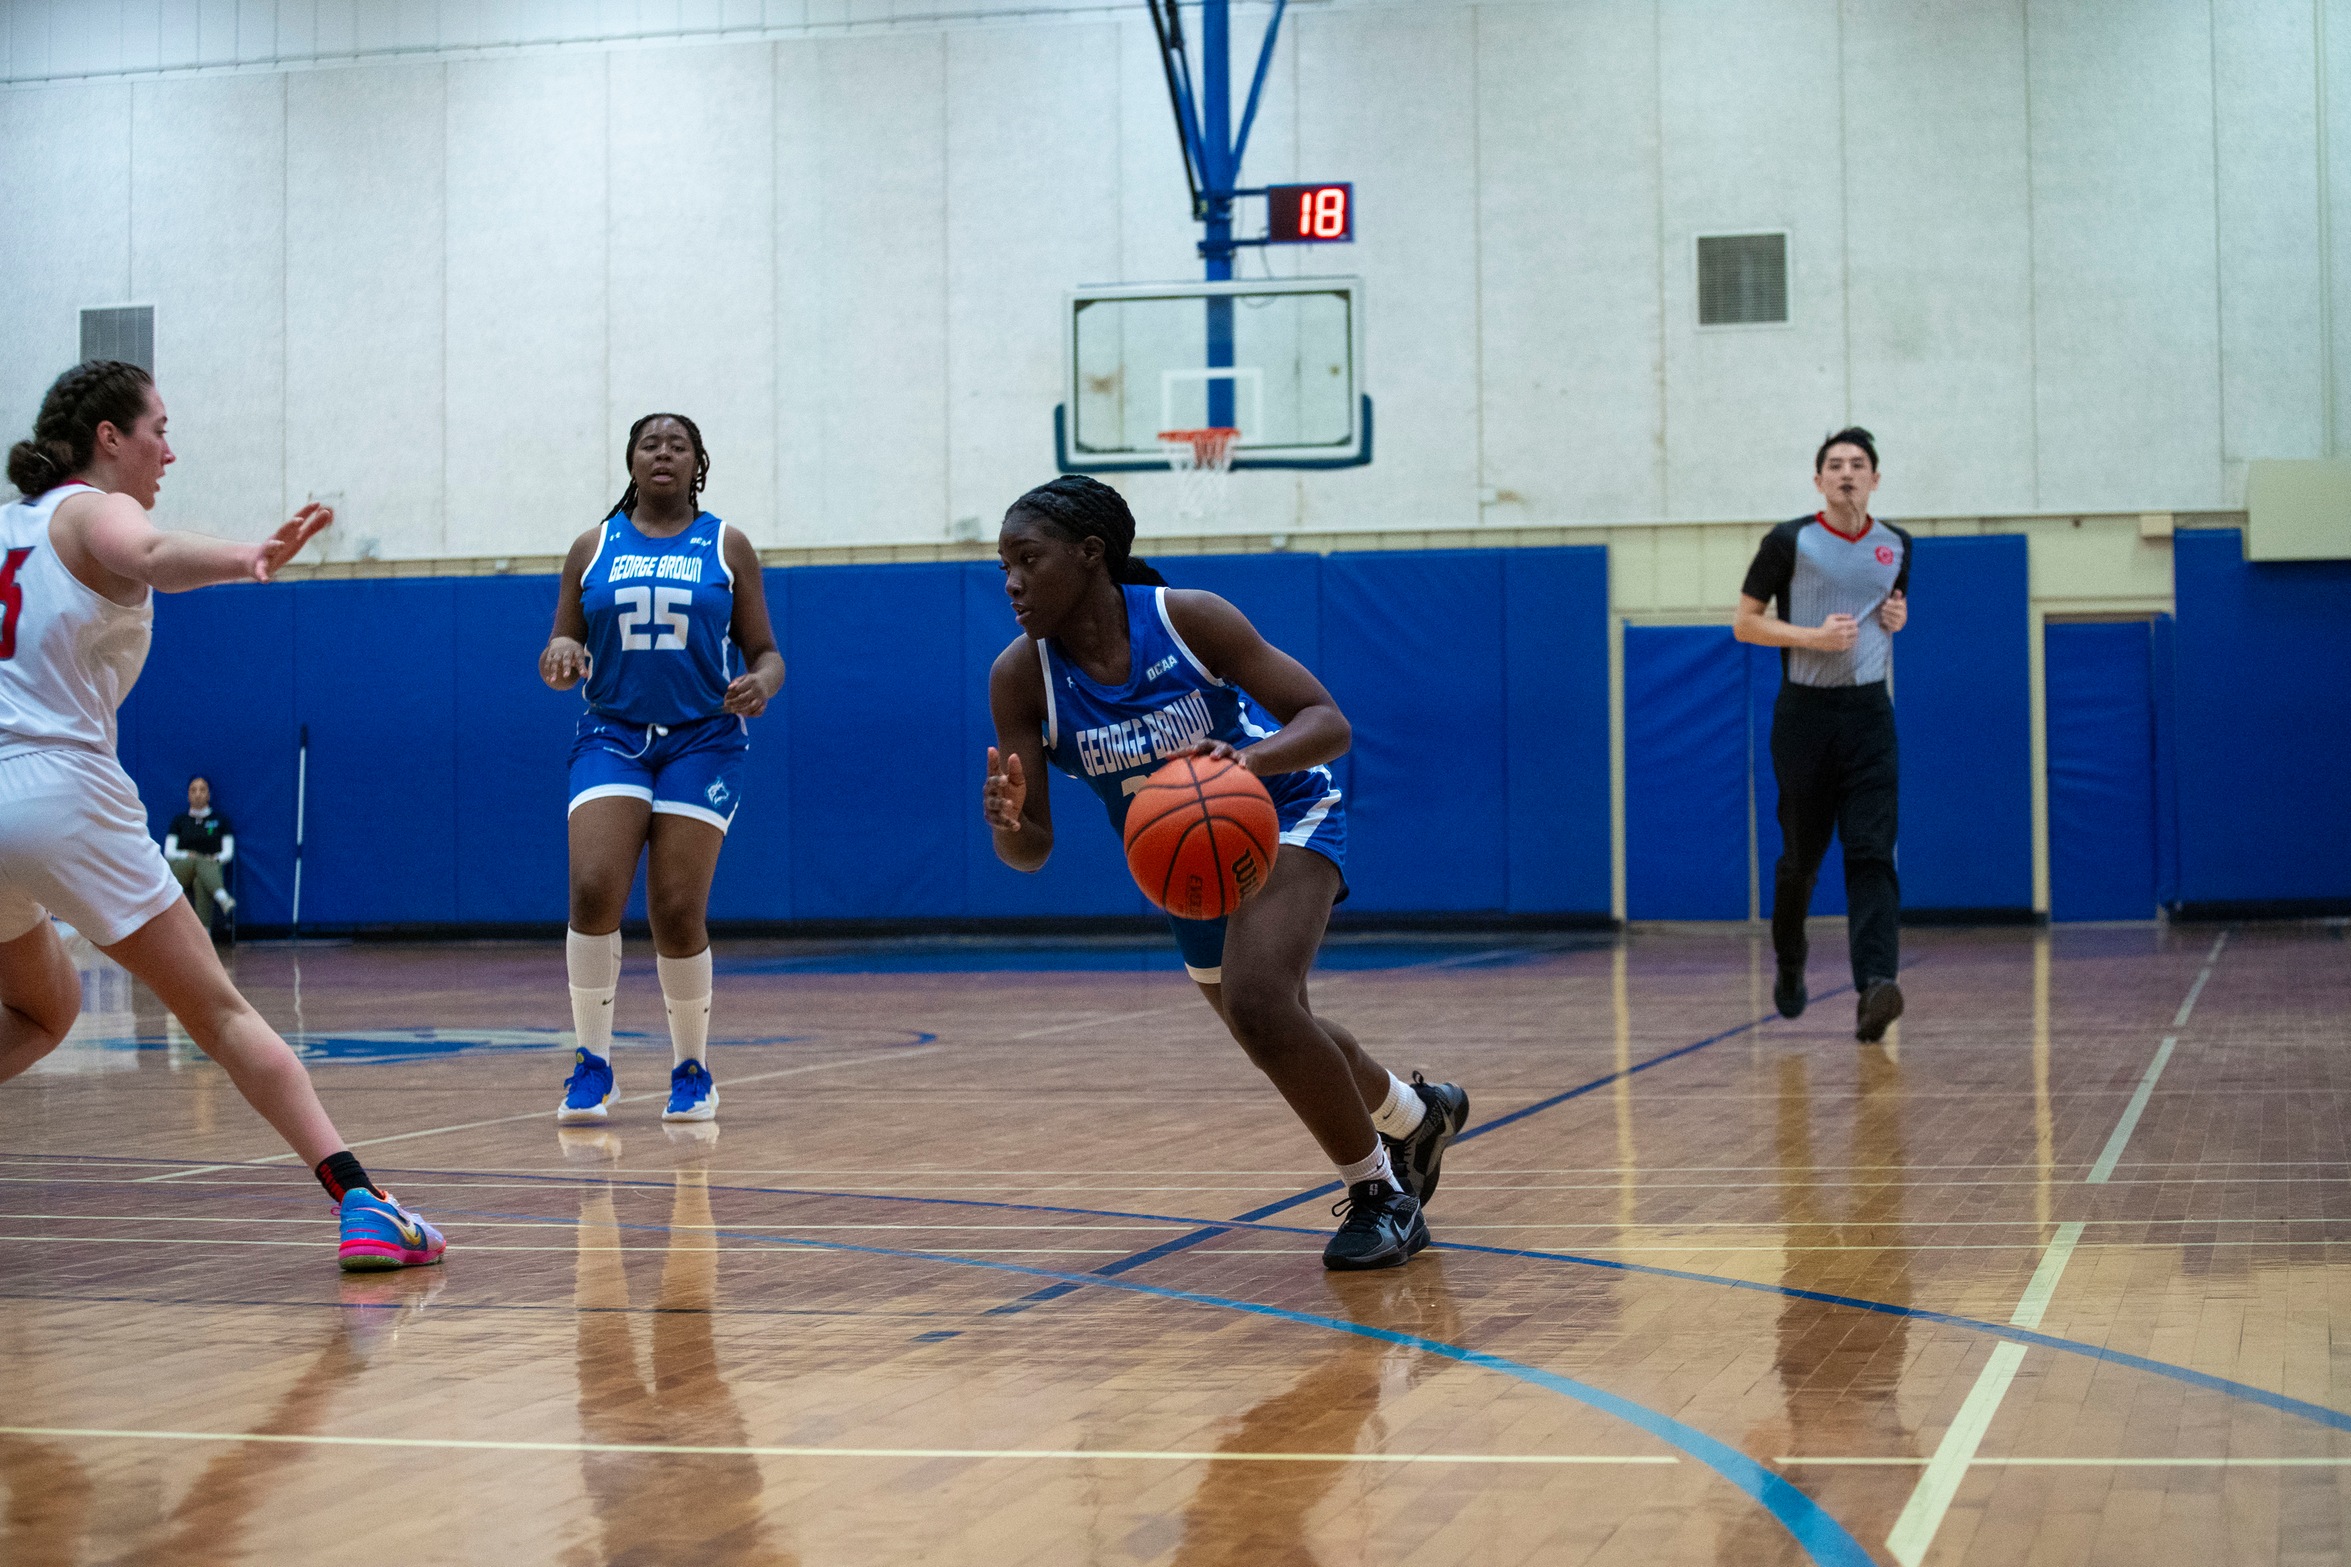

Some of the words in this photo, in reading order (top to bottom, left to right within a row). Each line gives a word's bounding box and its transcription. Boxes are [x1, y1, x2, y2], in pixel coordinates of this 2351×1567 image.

[1299, 188, 1345, 238] 18
[608, 554, 658, 583] GEORGE
[656, 554, 703, 583] BROWN
[615, 586, 693, 651] 25
[1146, 654, 1178, 682] OCAA
[1076, 718, 1152, 777] GEORGE
[1142, 688, 1215, 760] BROWN
